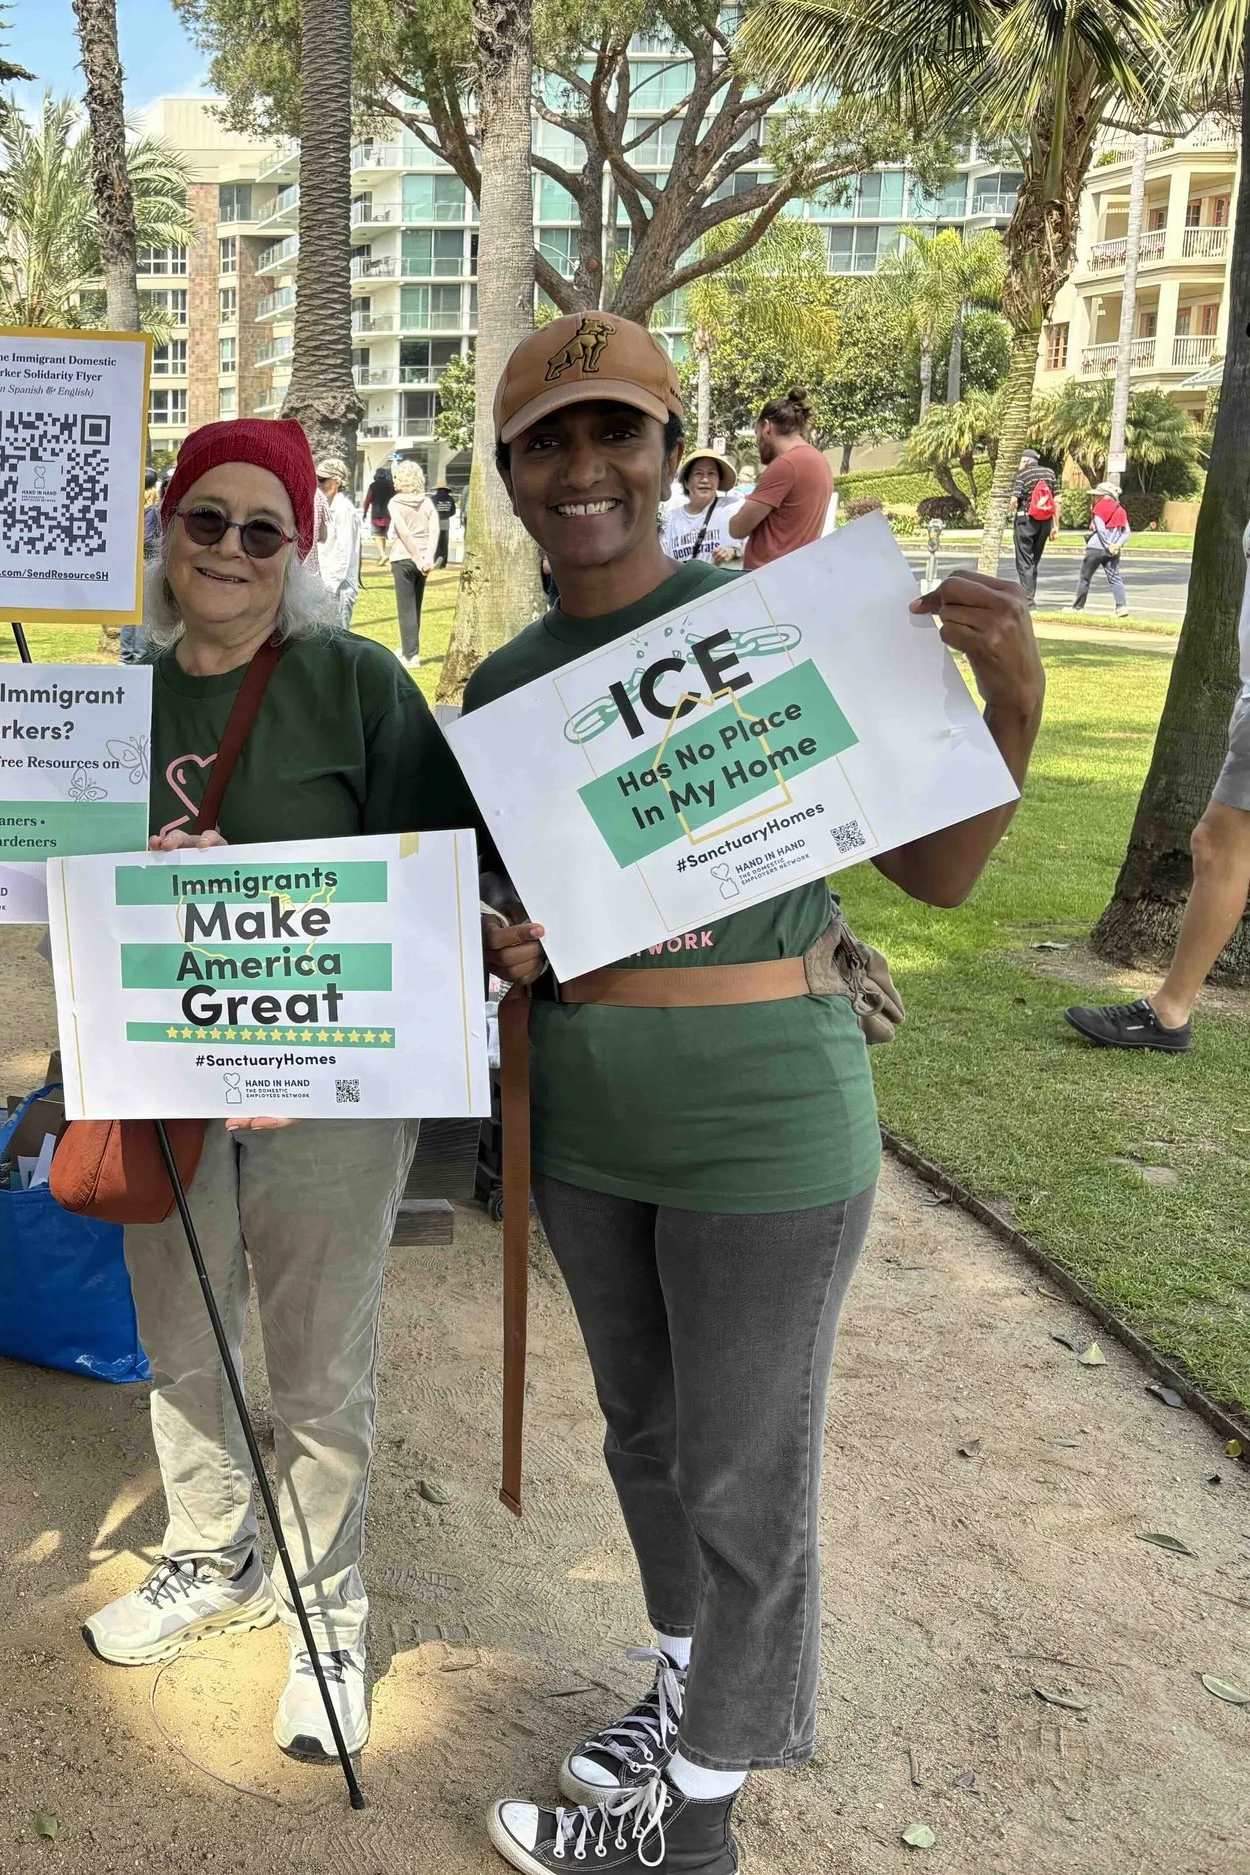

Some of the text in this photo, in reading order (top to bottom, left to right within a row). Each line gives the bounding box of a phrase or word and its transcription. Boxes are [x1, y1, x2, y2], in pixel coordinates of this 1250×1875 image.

[12, 353, 66, 365] Immigrant
[69, 355, 117, 366] Domestic
[24, 368, 74, 382] Solidarity
[76, 371, 103, 382] Flyer
[8, 384, 44, 395] Spanish
[45, 386, 56, 394] &
[58, 386, 94, 398] English)
[0, 682, 125, 709] Immigrant
[608, 628, 754, 740] ICE
[27, 757, 99, 769] Resources
[102, 760, 120, 769] on
[616, 703, 802, 797] Has No Place
[631, 737, 817, 830] In My Home
[676, 803, 825, 873] #SanctuaryHomes
[735, 838, 806, 874] HAND IN HAND
[172, 866, 339, 899] Immigrants
[184, 896, 331, 944] Make
[629, 931, 714, 957] WORK
[176, 945, 341, 982] America
[181, 983, 343, 1027] Great
[195, 1053, 337, 1069] #SanctuaryHomes
[245, 1079, 310, 1087] HAND IN HAND
